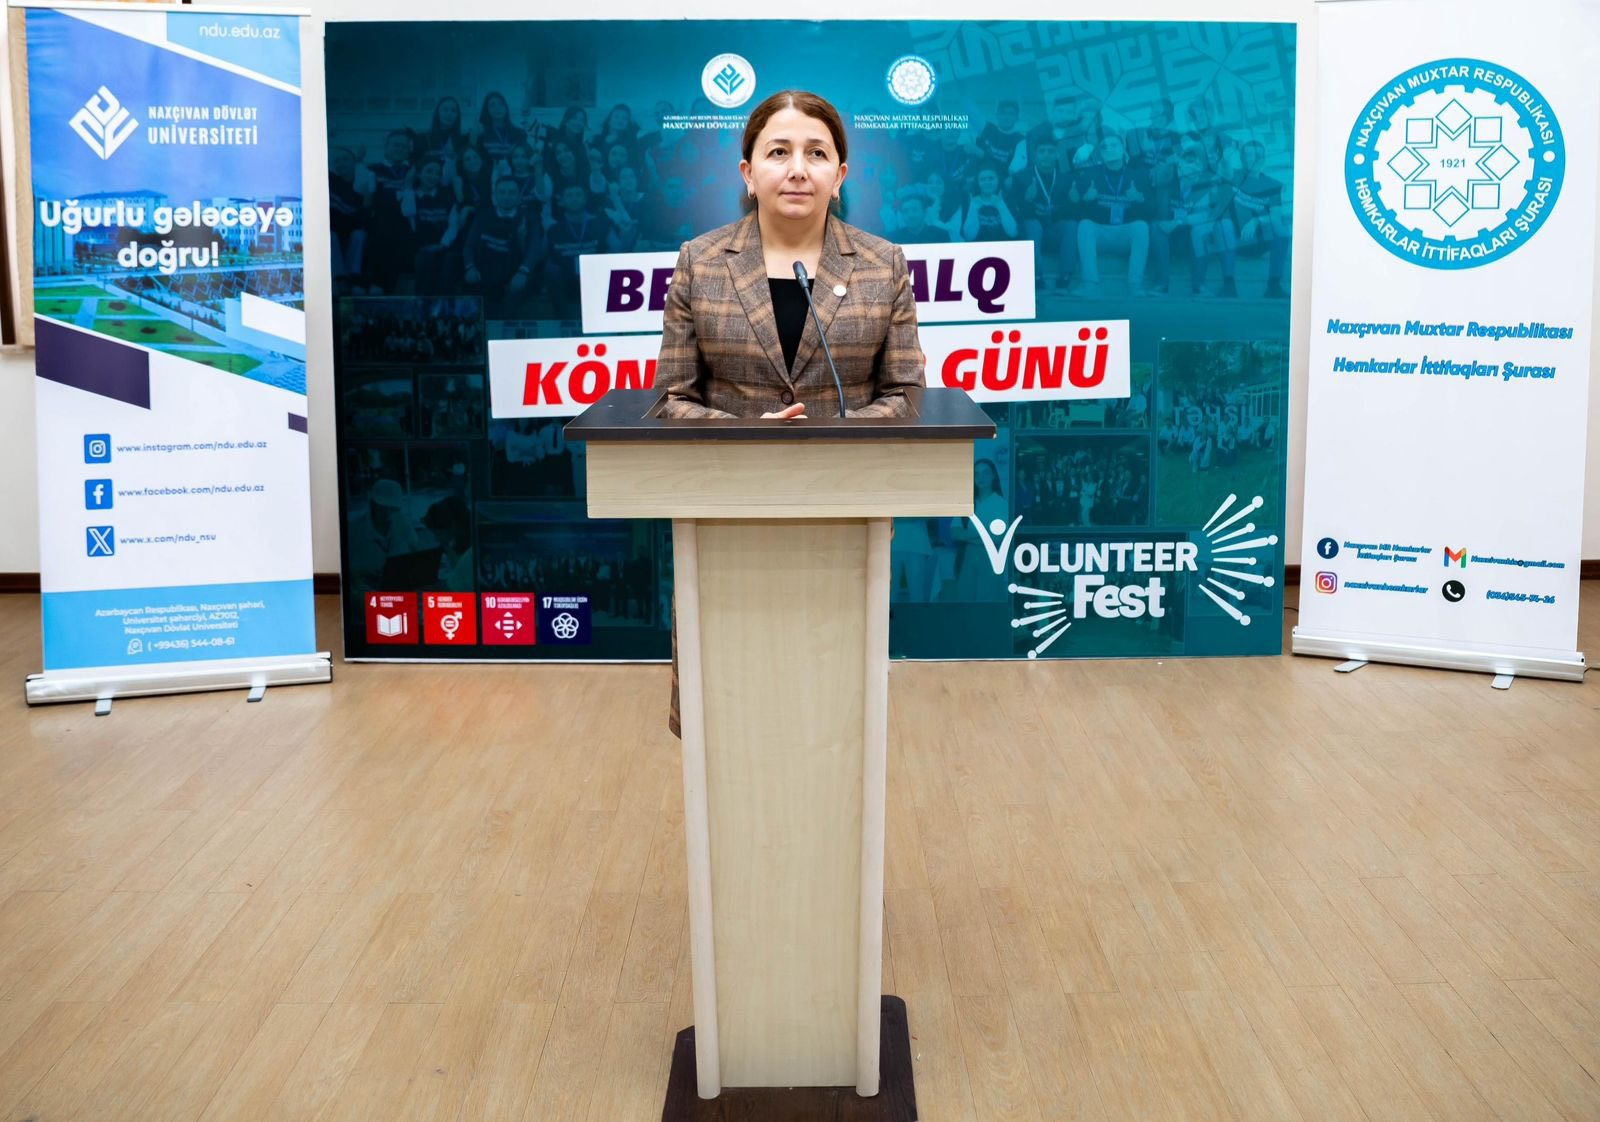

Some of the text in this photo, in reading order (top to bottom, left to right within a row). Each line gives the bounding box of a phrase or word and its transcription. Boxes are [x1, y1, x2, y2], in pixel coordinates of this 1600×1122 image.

[199, 23, 281, 38] ndu.edu.az
[148, 105, 258, 122] NAXÇIVAN DÖVLƏT
[1356, 66, 1554, 148] NAXÇIVAN MUXTAR RESPUBLİKASI
[706, 121, 740, 129] DÖVLƏT
[945, 122, 968, 130] ŞURASI
[147, 123, 258, 145] UNİVERSİTETİ
[1440, 159, 1465, 168] 1921
[39, 199, 293, 235] Uğurlu gələcəyə
[1355, 177, 1552, 261] HƏMKARLAR İTTİFAQLARI ŞURASI
[117, 240, 219, 274] doğru!
[1327, 319, 1573, 341] Naxçıvan Muxtar Respublikası
[941, 327, 1109, 391] GÜNÜ
[1420, 355, 1499, 379] İttifaqları
[1502, 361, 1556, 381] Şurası
[116, 440, 268, 453] www.instagram.com/ndu.edu.az
[118, 484, 264, 496] www.facebook.com/ndu.edu.az
[120, 533, 216, 544] www.x.com/ndu_nsu
[969, 514, 1198, 575] VOLUNTEER
[370, 596, 377, 608] 4
[428, 596, 435, 608] 5
[485, 596, 496, 608] 10
[542, 596, 552, 609] 17
[1074, 575, 1165, 619] Fest
